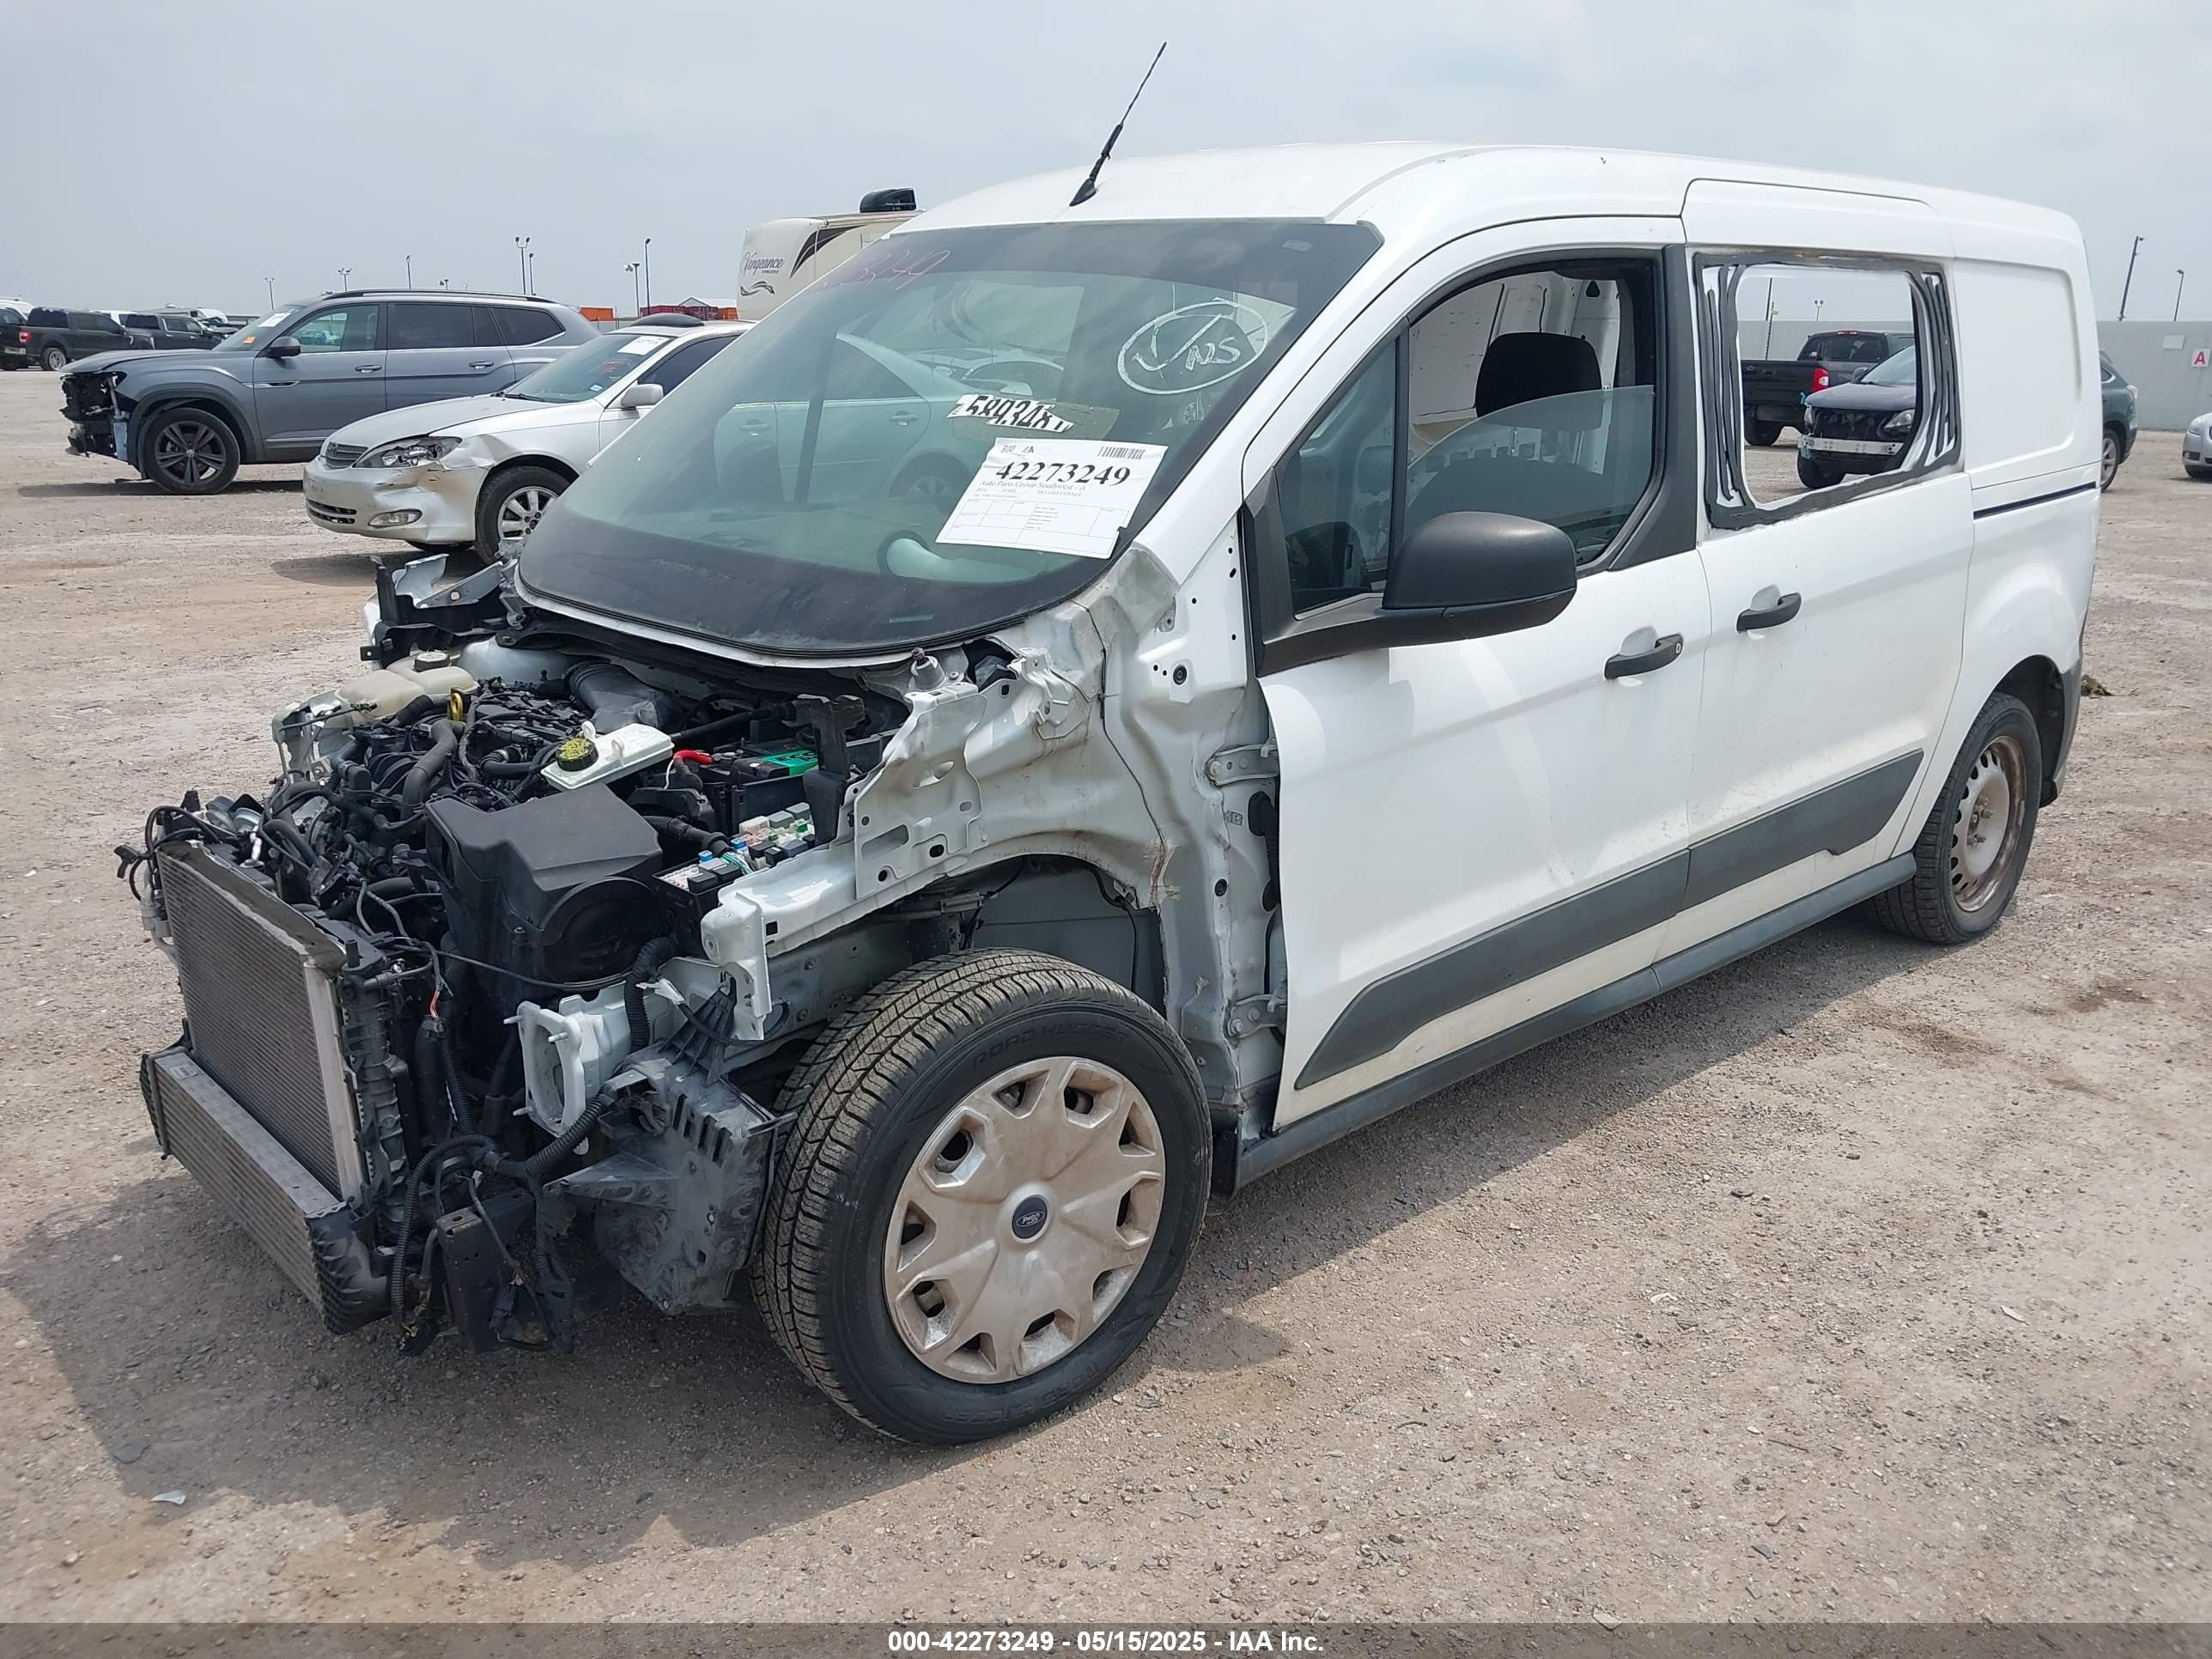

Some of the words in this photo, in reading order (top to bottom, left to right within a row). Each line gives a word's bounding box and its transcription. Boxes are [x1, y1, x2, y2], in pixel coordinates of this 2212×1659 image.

[740, 251, 785, 276] Vengeance
[2194, 350, 2206, 365] A
[994, 461, 1131, 487] 42273249
[1015, 480, 1037, 489] Group
[1037, 481, 1074, 491] Southwest
